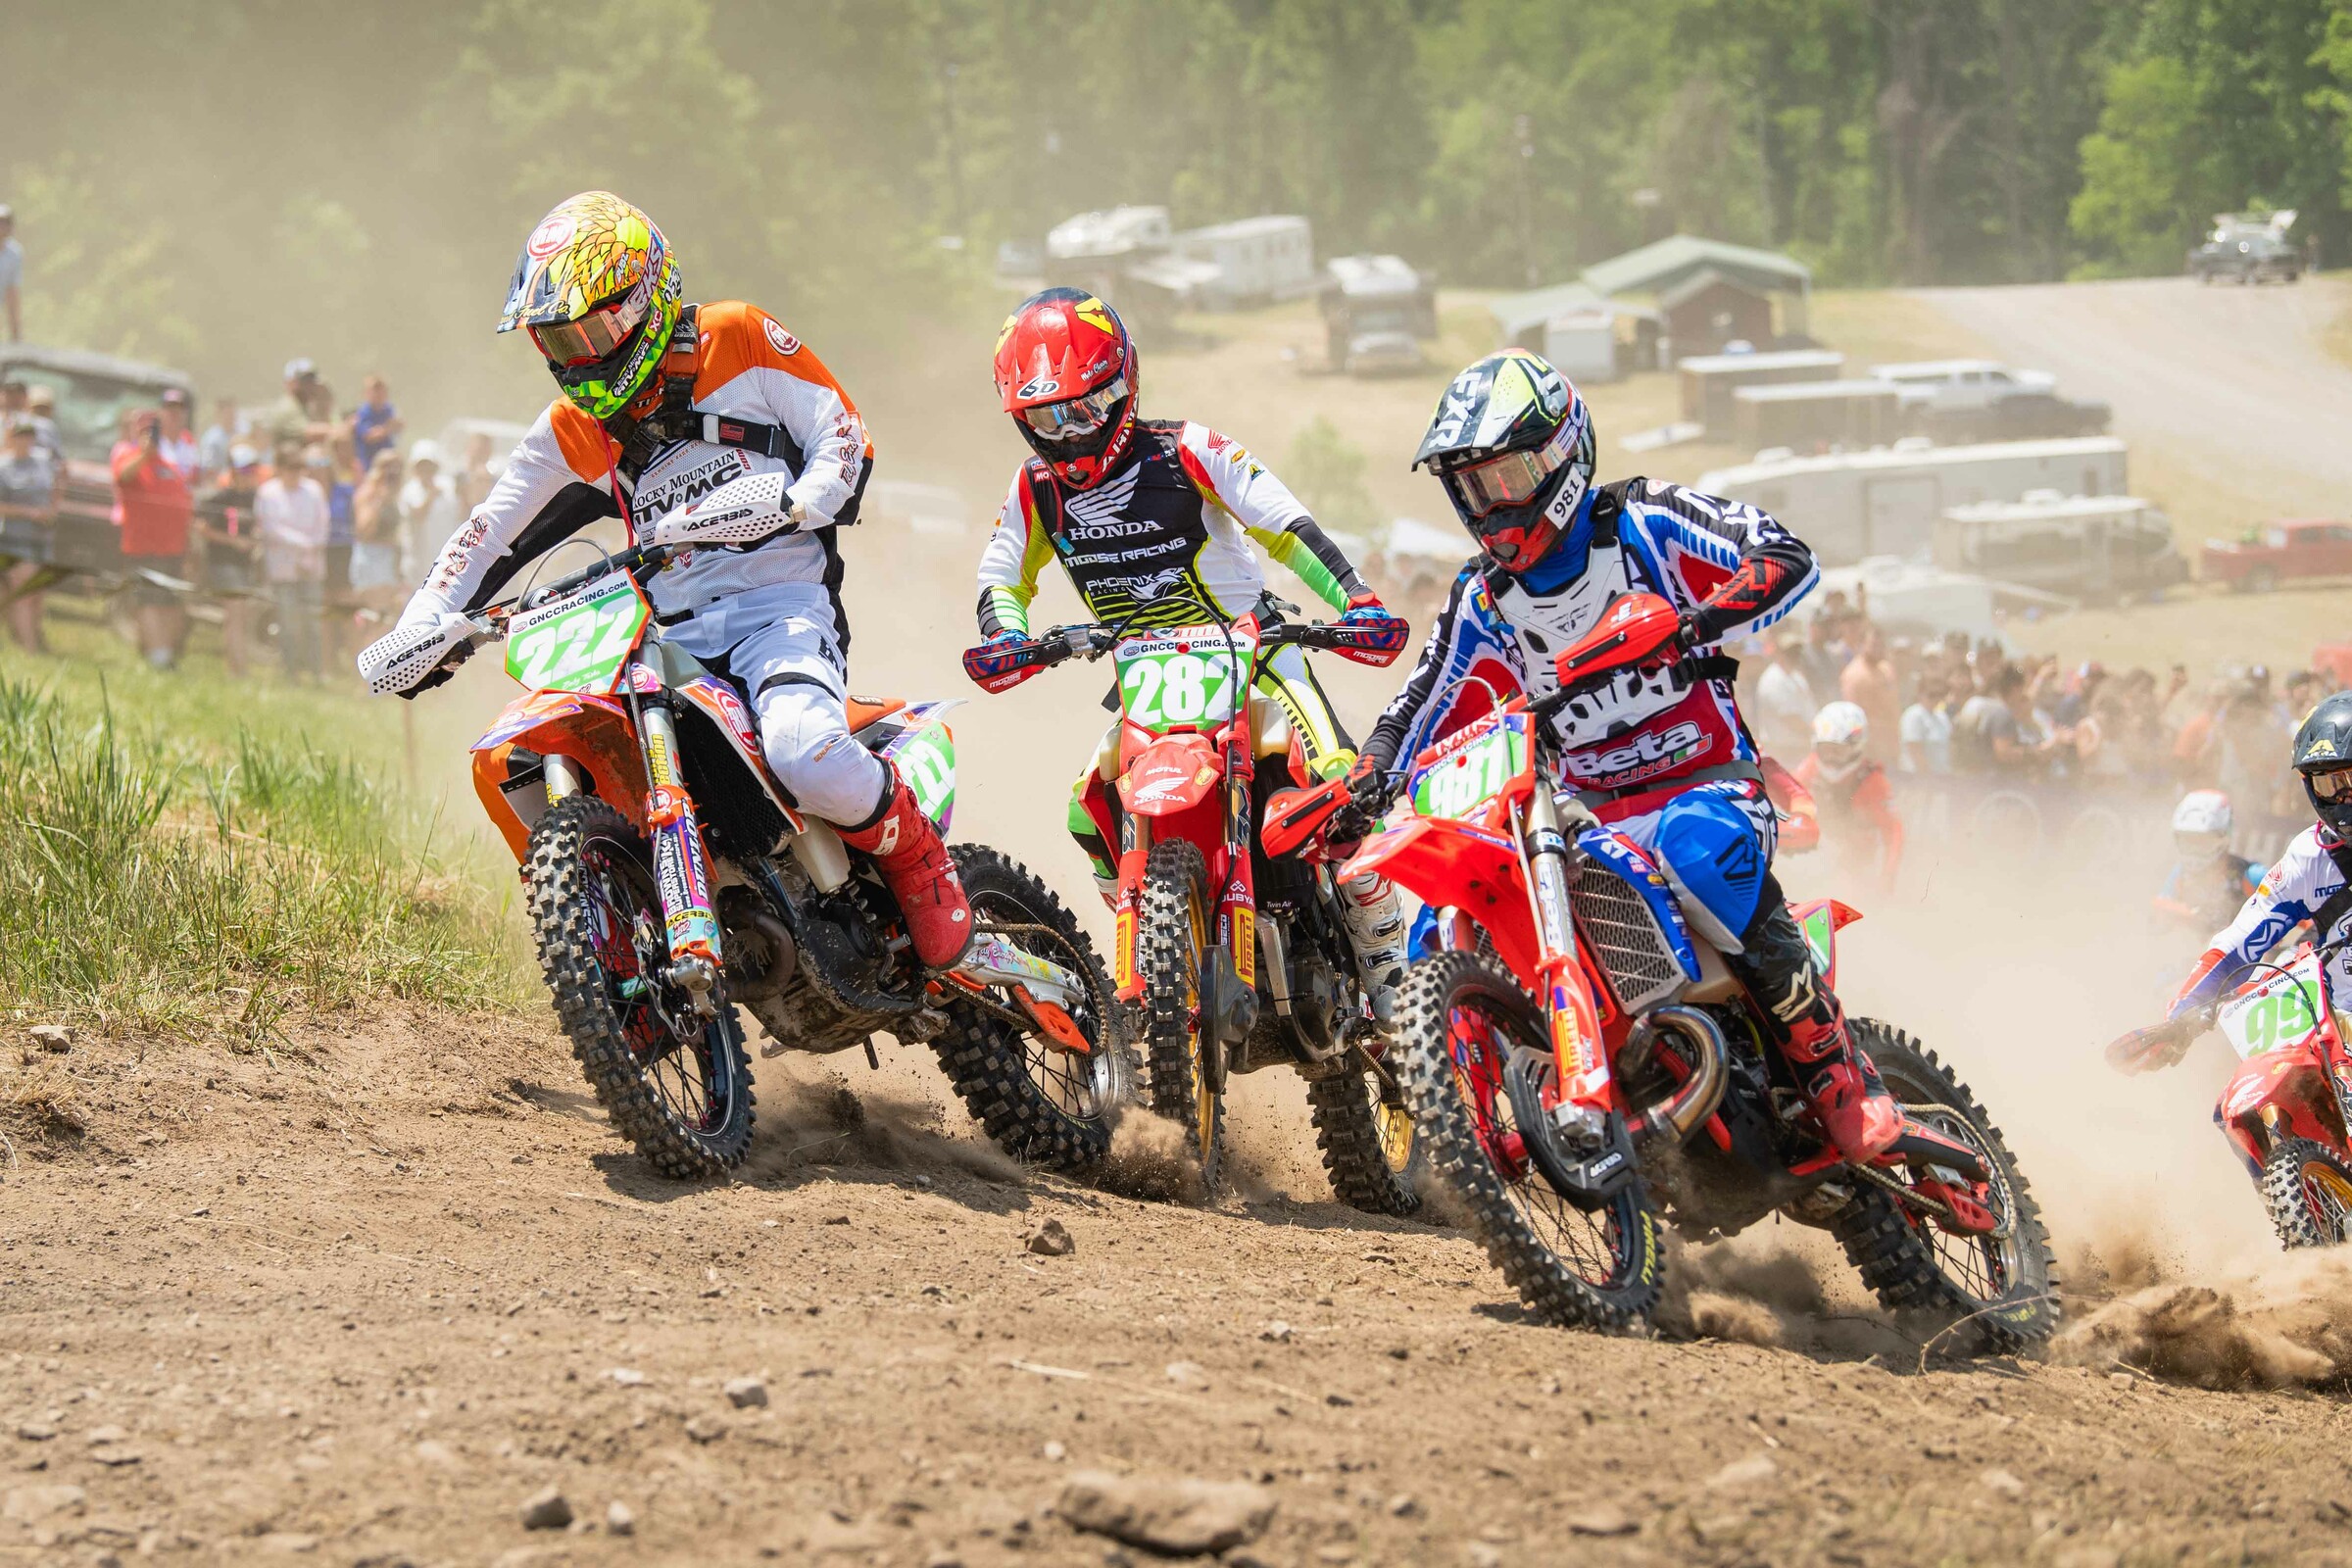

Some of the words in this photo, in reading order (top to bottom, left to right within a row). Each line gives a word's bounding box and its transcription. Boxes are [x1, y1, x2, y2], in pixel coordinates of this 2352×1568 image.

[514, 304, 547, 319] Fuel
[548, 299, 571, 315] Co.
[1016, 376, 1060, 400] 6D
[1427, 370, 1483, 449] FXR
[669, 450, 736, 490] MOUNTAIN
[1552, 478, 1580, 518] 981
[687, 507, 754, 533] ACERBIS
[1068, 519, 1164, 542] HONDA
[1064, 552, 1120, 568] MOOSE
[1121, 537, 1188, 563] RACING
[1085, 573, 1157, 591] PHOENIX
[1090, 586, 1128, 597] RACING
[528, 580, 629, 627] GNCCRACING.COM
[385, 632, 447, 671] ACERBIS
[515, 594, 638, 688] 222
[1140, 638, 1247, 654] GNCCCING.COM
[1124, 653, 1248, 728] 282
[1427, 722, 1512, 777] GNCCRACING.CM
[1568, 721, 1701, 778] Beta
[1428, 739, 1504, 818] 981
[1587, 756, 1671, 788] RACING
[1133, 791, 1188, 806] HONDA
[683, 800, 709, 904] DUNLOP
[666, 856, 684, 910] SUPERSTORE
[1116, 898, 1146, 913] UBA
[1219, 913, 1229, 947] SECO
[1239, 912, 1253, 979] PIRELLI
[2233, 967, 2311, 1010] GNCCCING.COM
[2244, 979, 2319, 1058] 99
